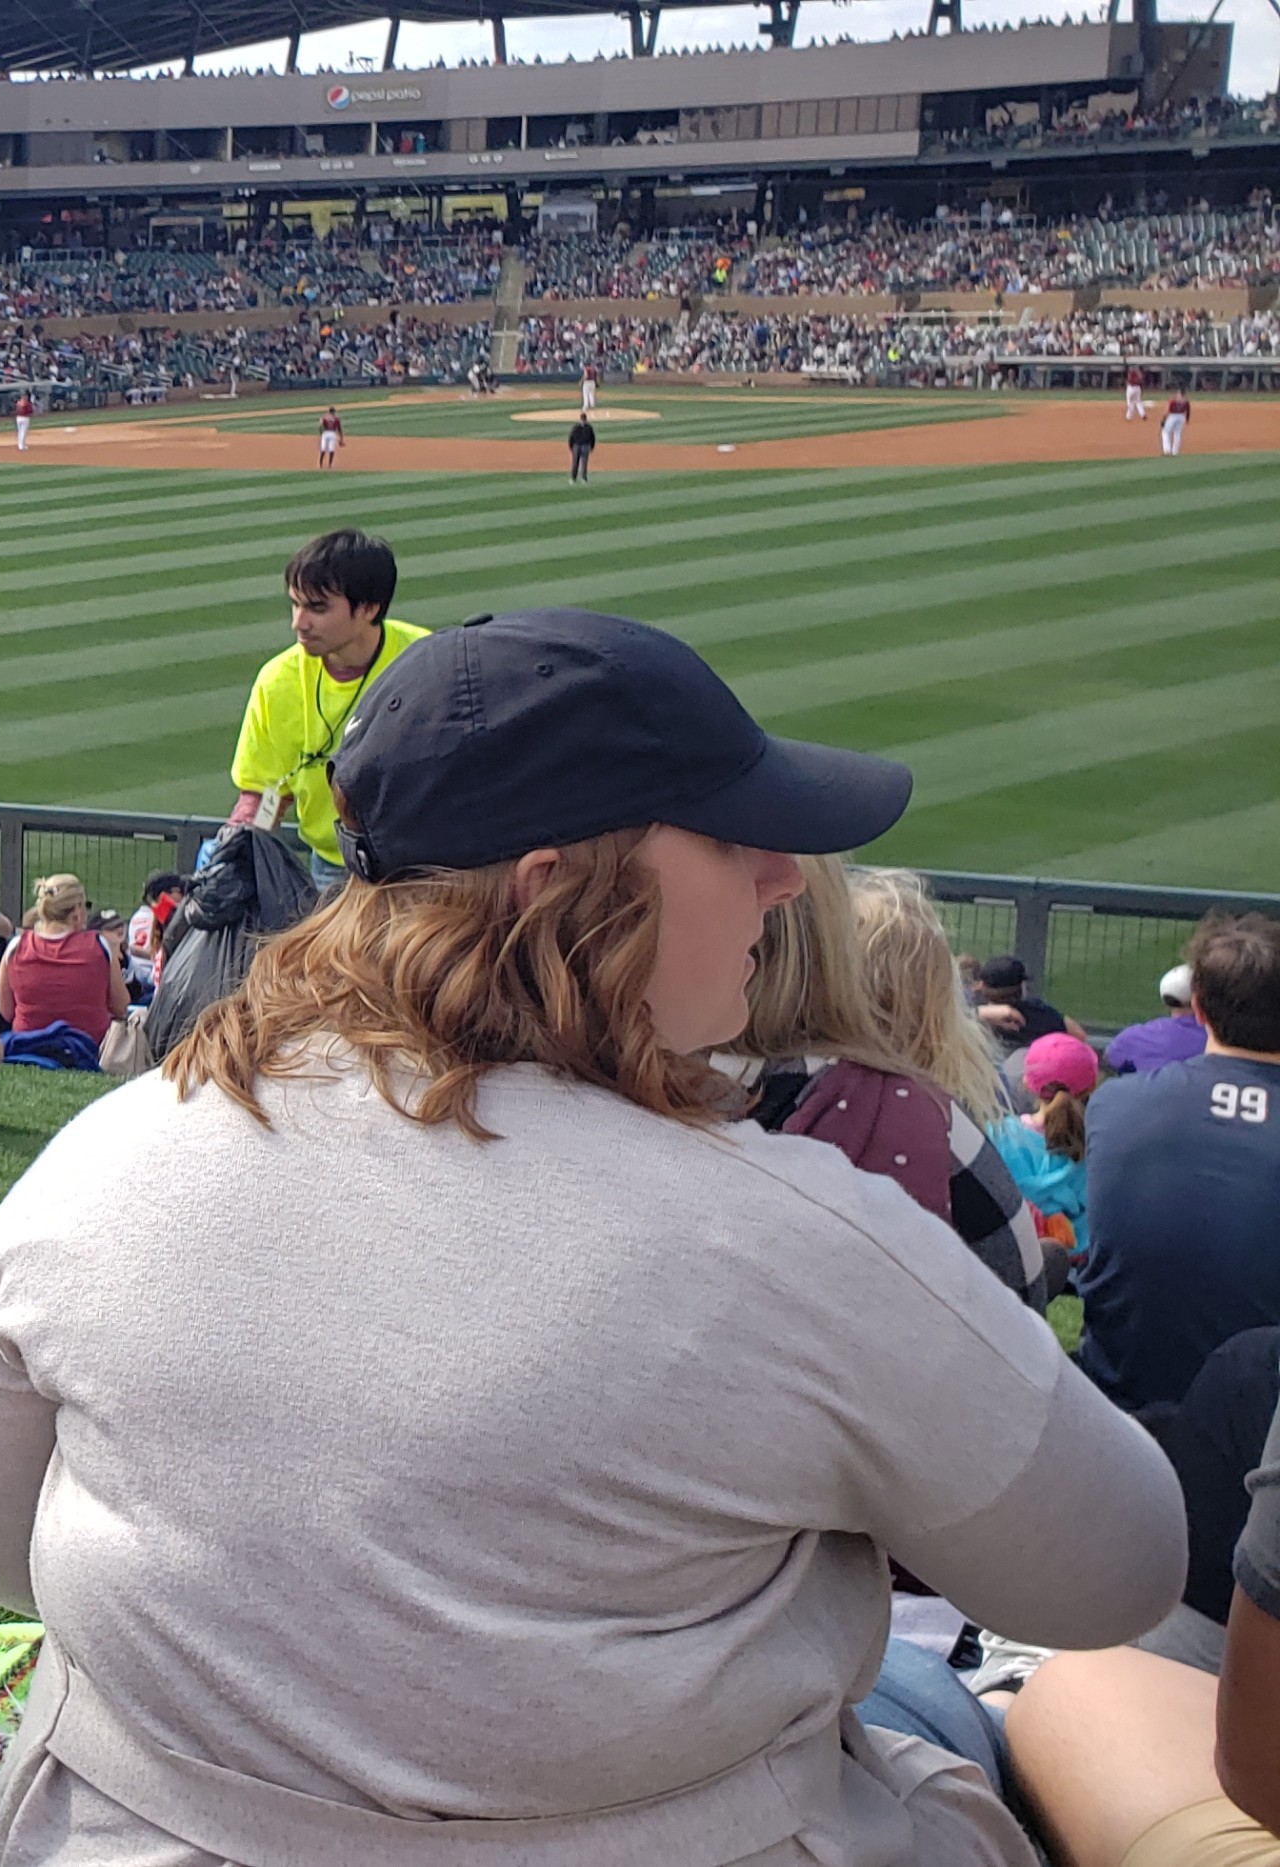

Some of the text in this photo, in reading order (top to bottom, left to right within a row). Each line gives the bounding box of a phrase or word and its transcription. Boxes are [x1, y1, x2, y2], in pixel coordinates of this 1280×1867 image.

[351, 87, 421, 103] pepsi patio
[1210, 1082, 1267, 1123] 99
